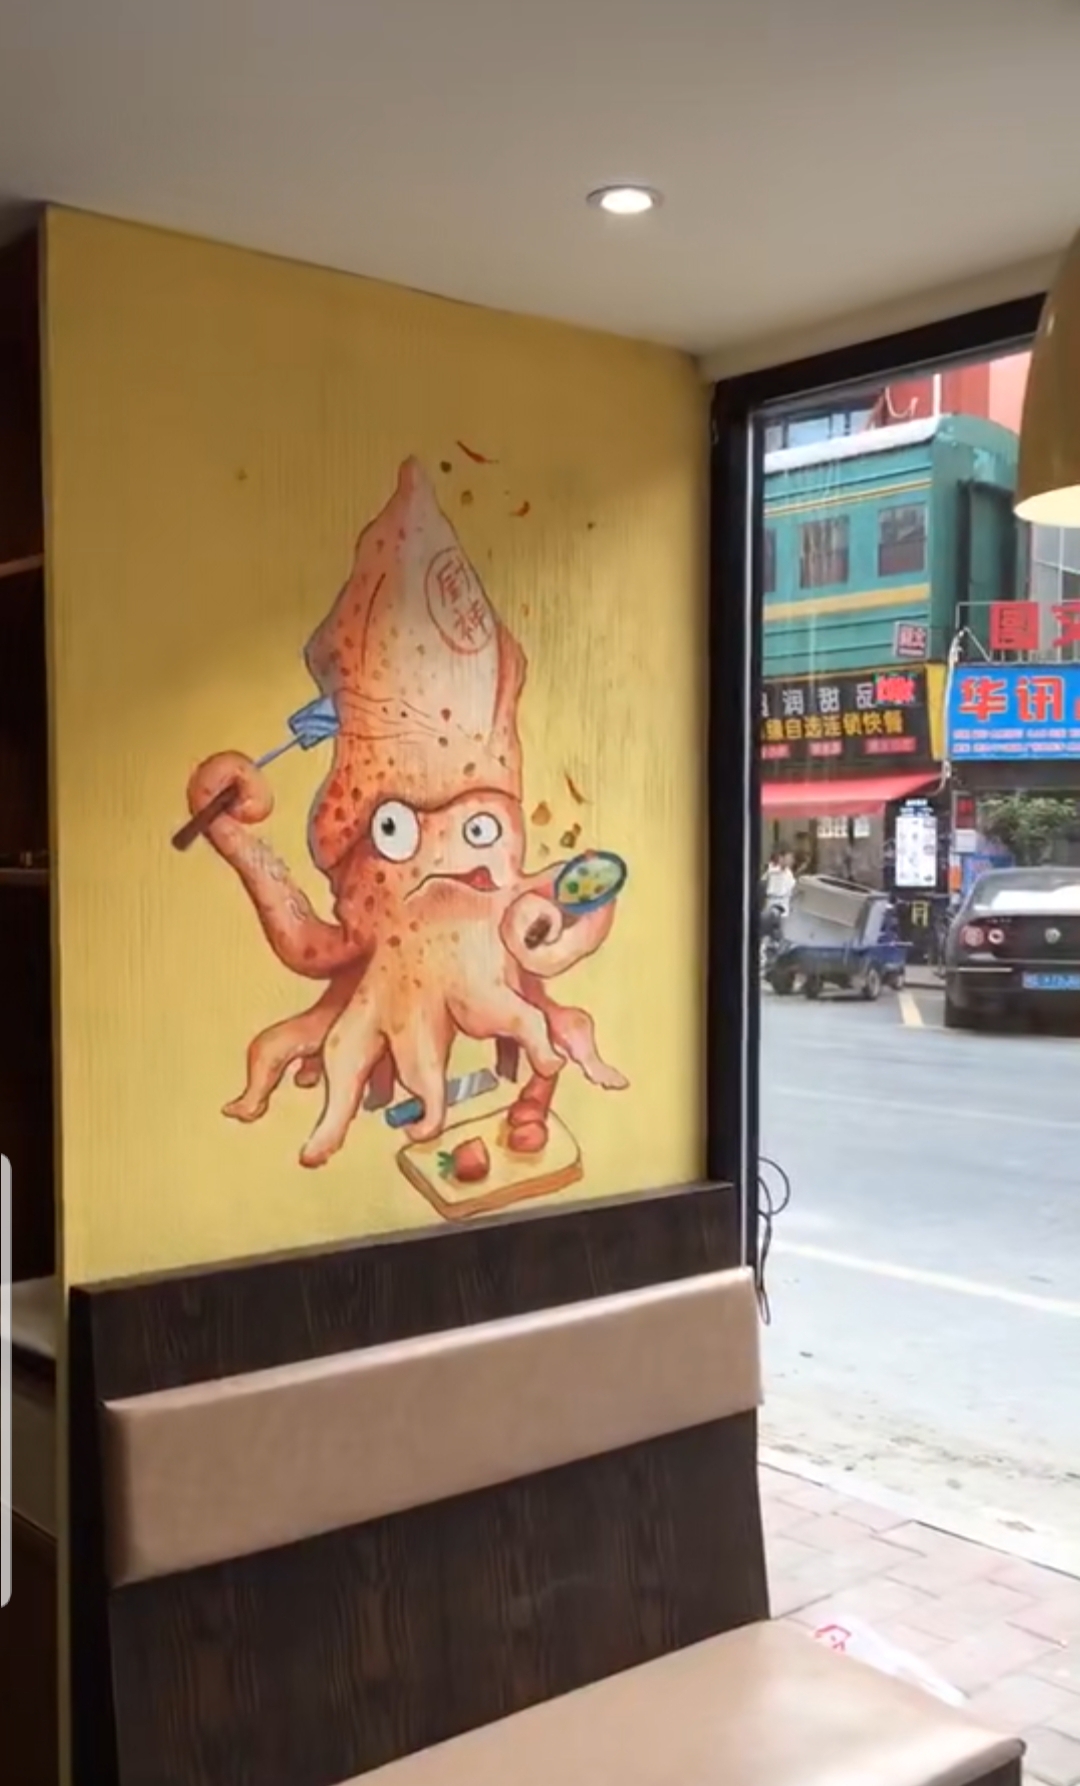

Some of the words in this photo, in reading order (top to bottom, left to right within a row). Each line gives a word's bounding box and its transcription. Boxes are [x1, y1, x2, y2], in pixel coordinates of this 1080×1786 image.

[761, 682, 876, 717] 润甜品
[958, 675, 1080, 722] 华讯
